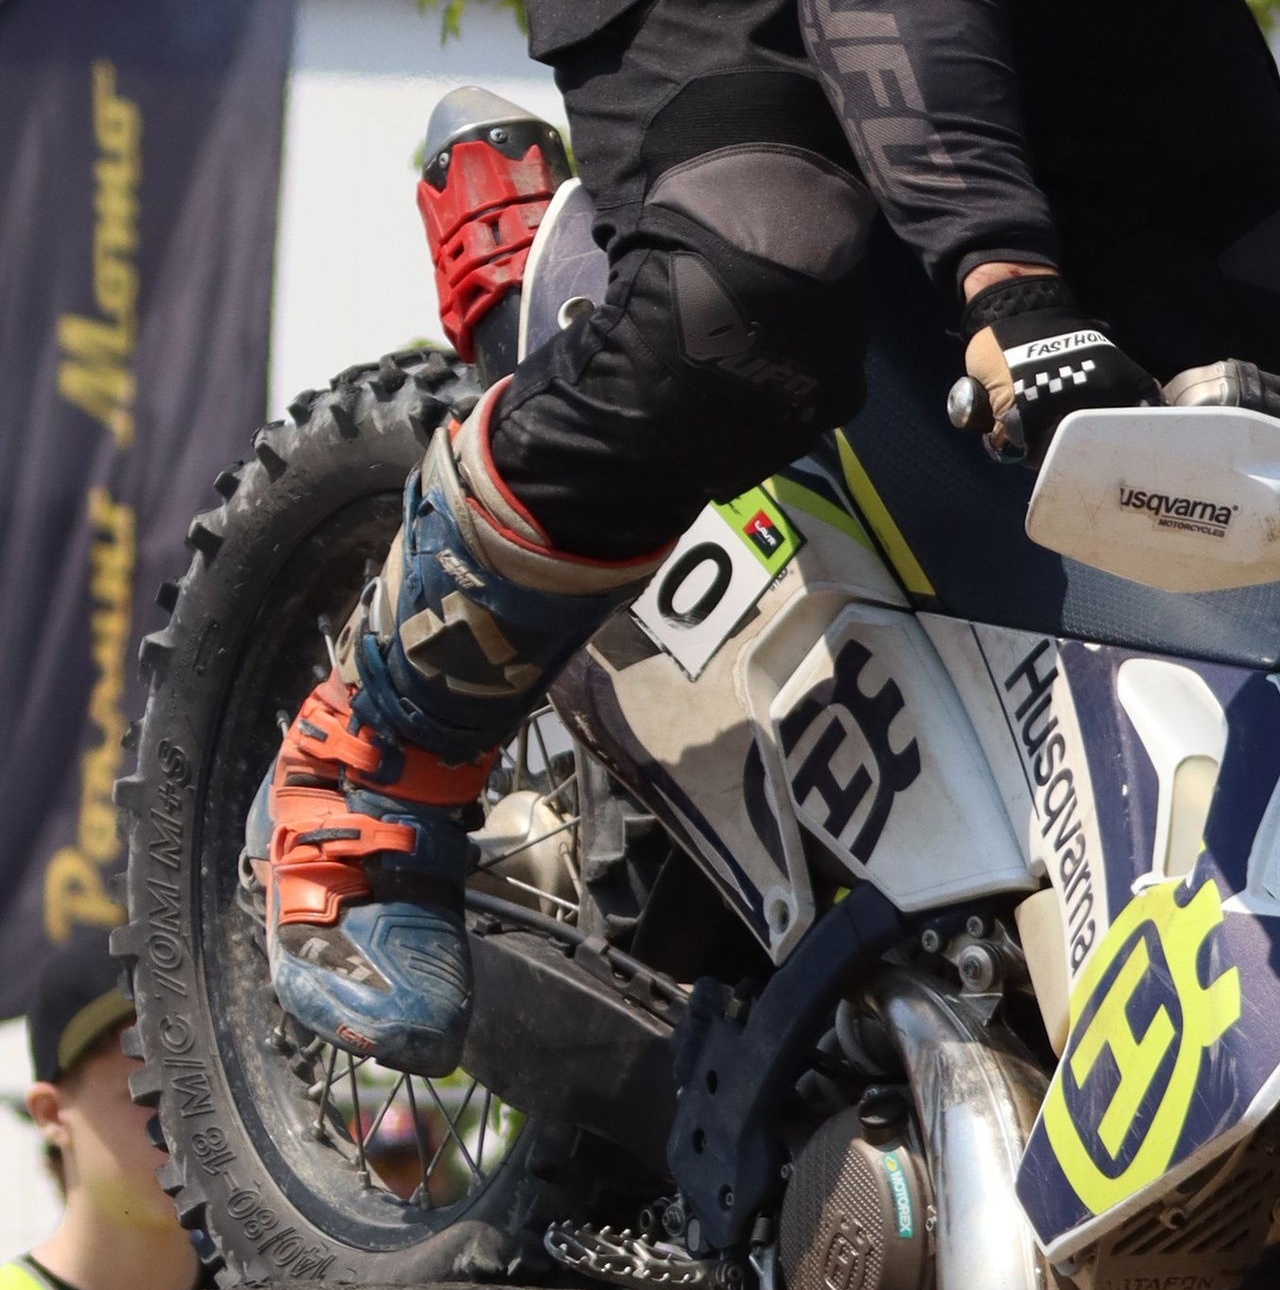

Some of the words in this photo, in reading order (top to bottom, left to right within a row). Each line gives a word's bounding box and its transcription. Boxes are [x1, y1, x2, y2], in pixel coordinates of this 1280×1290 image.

[1158, 517, 1226, 538] MOTORCYCLES
[1004, 638, 1097, 979] Husqvarna
[889, 1170, 912, 1234] MOTOREX
